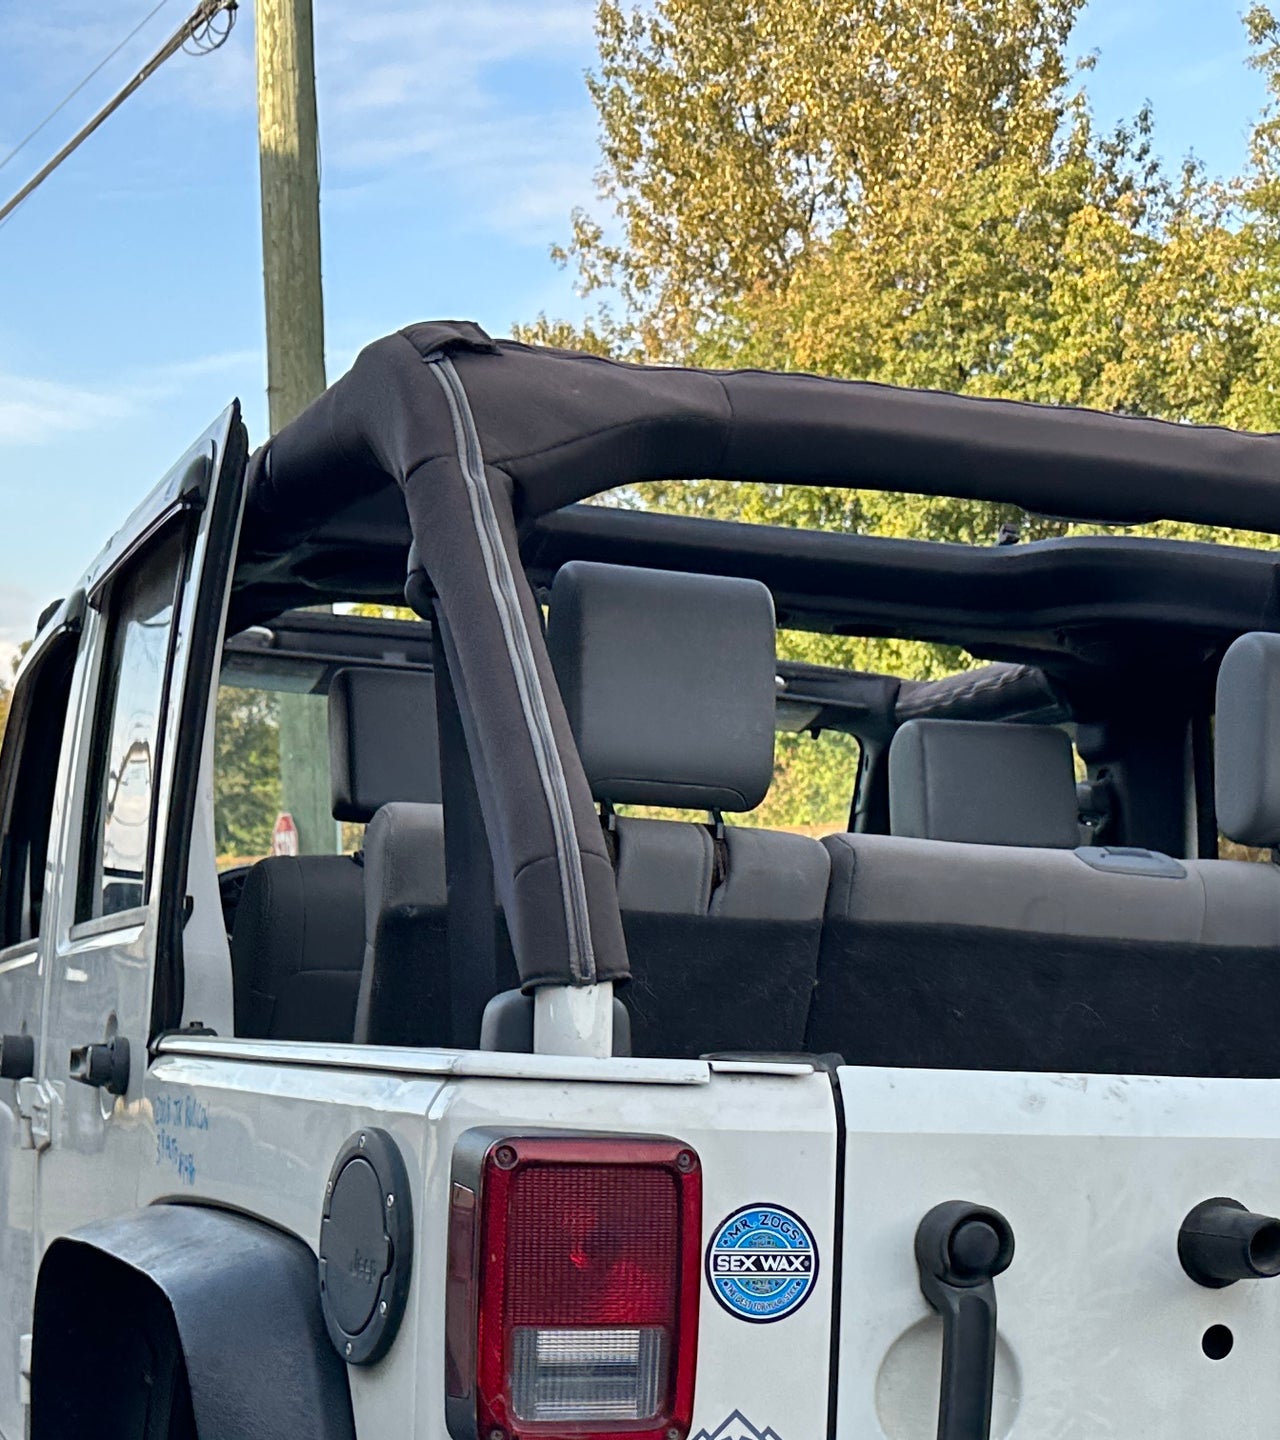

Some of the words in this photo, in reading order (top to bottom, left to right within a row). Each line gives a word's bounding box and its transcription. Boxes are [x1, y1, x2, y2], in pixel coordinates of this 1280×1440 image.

[760, 1214, 800, 1241] ZOGS
[717, 1256, 757, 1271] SEX
[760, 1256, 805, 1271] WAX
